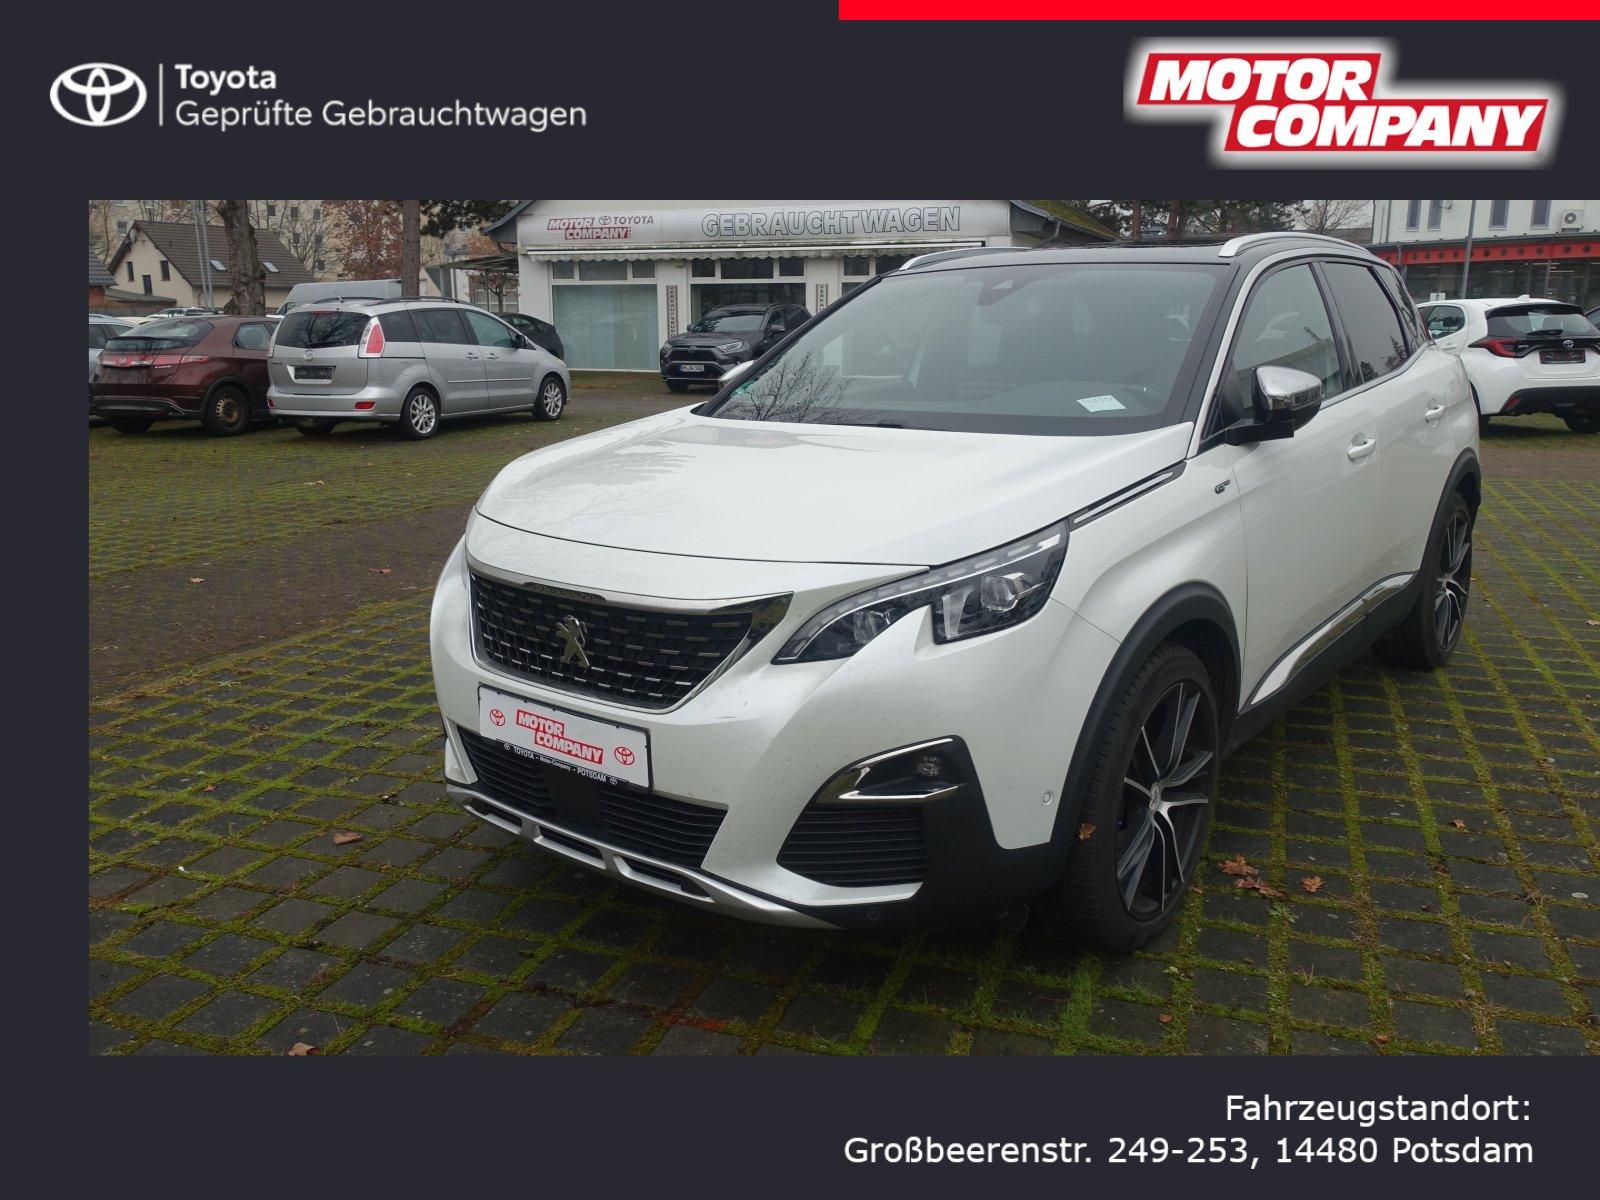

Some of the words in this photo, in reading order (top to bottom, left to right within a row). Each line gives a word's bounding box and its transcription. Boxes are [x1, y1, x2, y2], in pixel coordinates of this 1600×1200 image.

[548, 218, 594, 231] MOTOR
[613, 215, 655, 225] TOYOTA
[701, 206, 961, 238] GEBRAUCHTWAGEN
[565, 227, 629, 240] COMPANY
[518, 711, 563, 737] MOTOR
[536, 731, 603, 762] COMPANY
[513, 746, 535, 760] TOYOTA
[577, 767, 607, 783] POTSDAM
